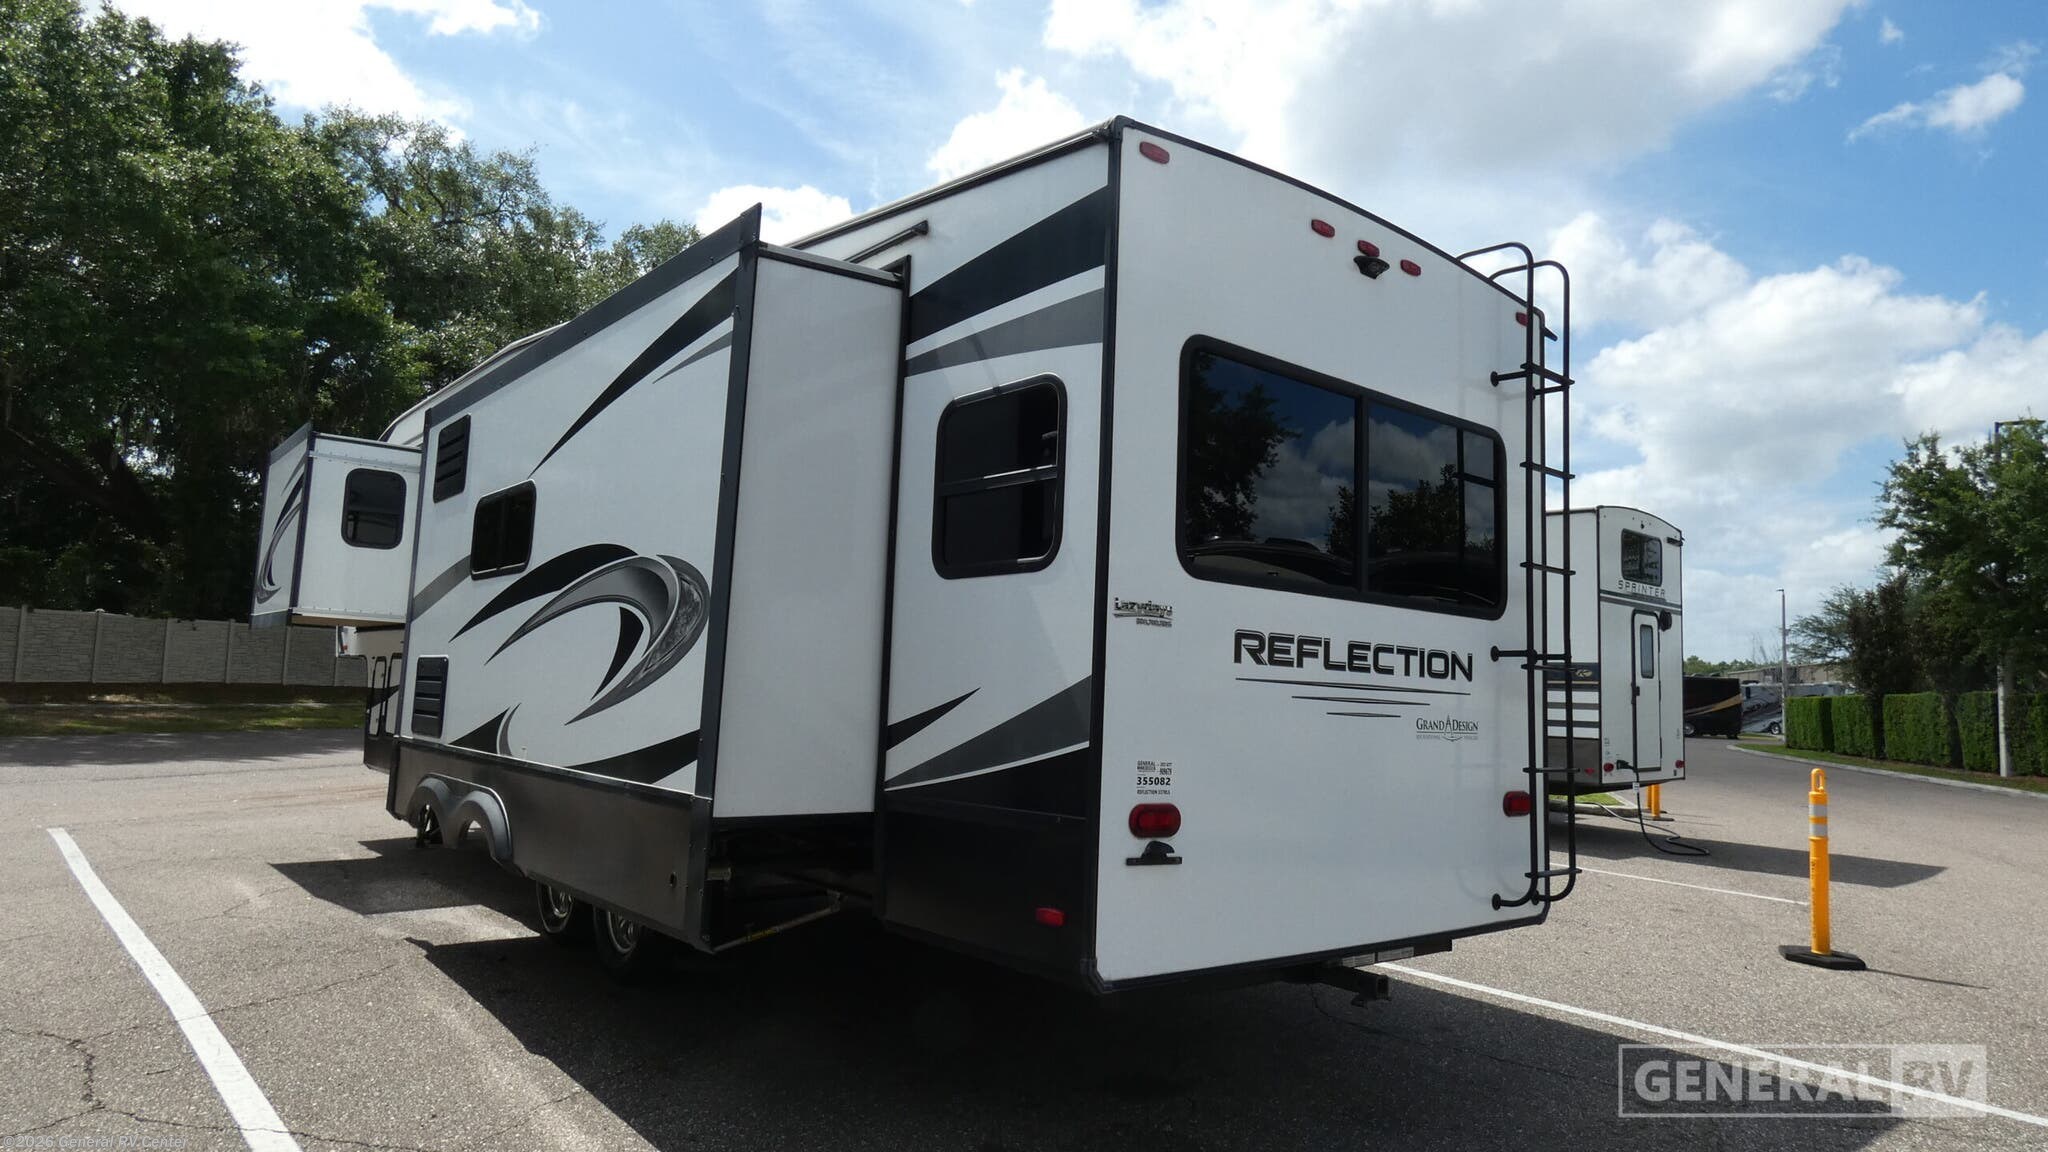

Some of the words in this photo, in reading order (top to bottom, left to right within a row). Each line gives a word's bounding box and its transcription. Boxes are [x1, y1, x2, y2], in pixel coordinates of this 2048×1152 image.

[1617, 579, 1666, 598] SPRINTER
[1233, 628, 1474, 683] REFLECTION
[1452, 719, 1480, 731] DESIGN
[1137, 776, 1171, 786] 355082
